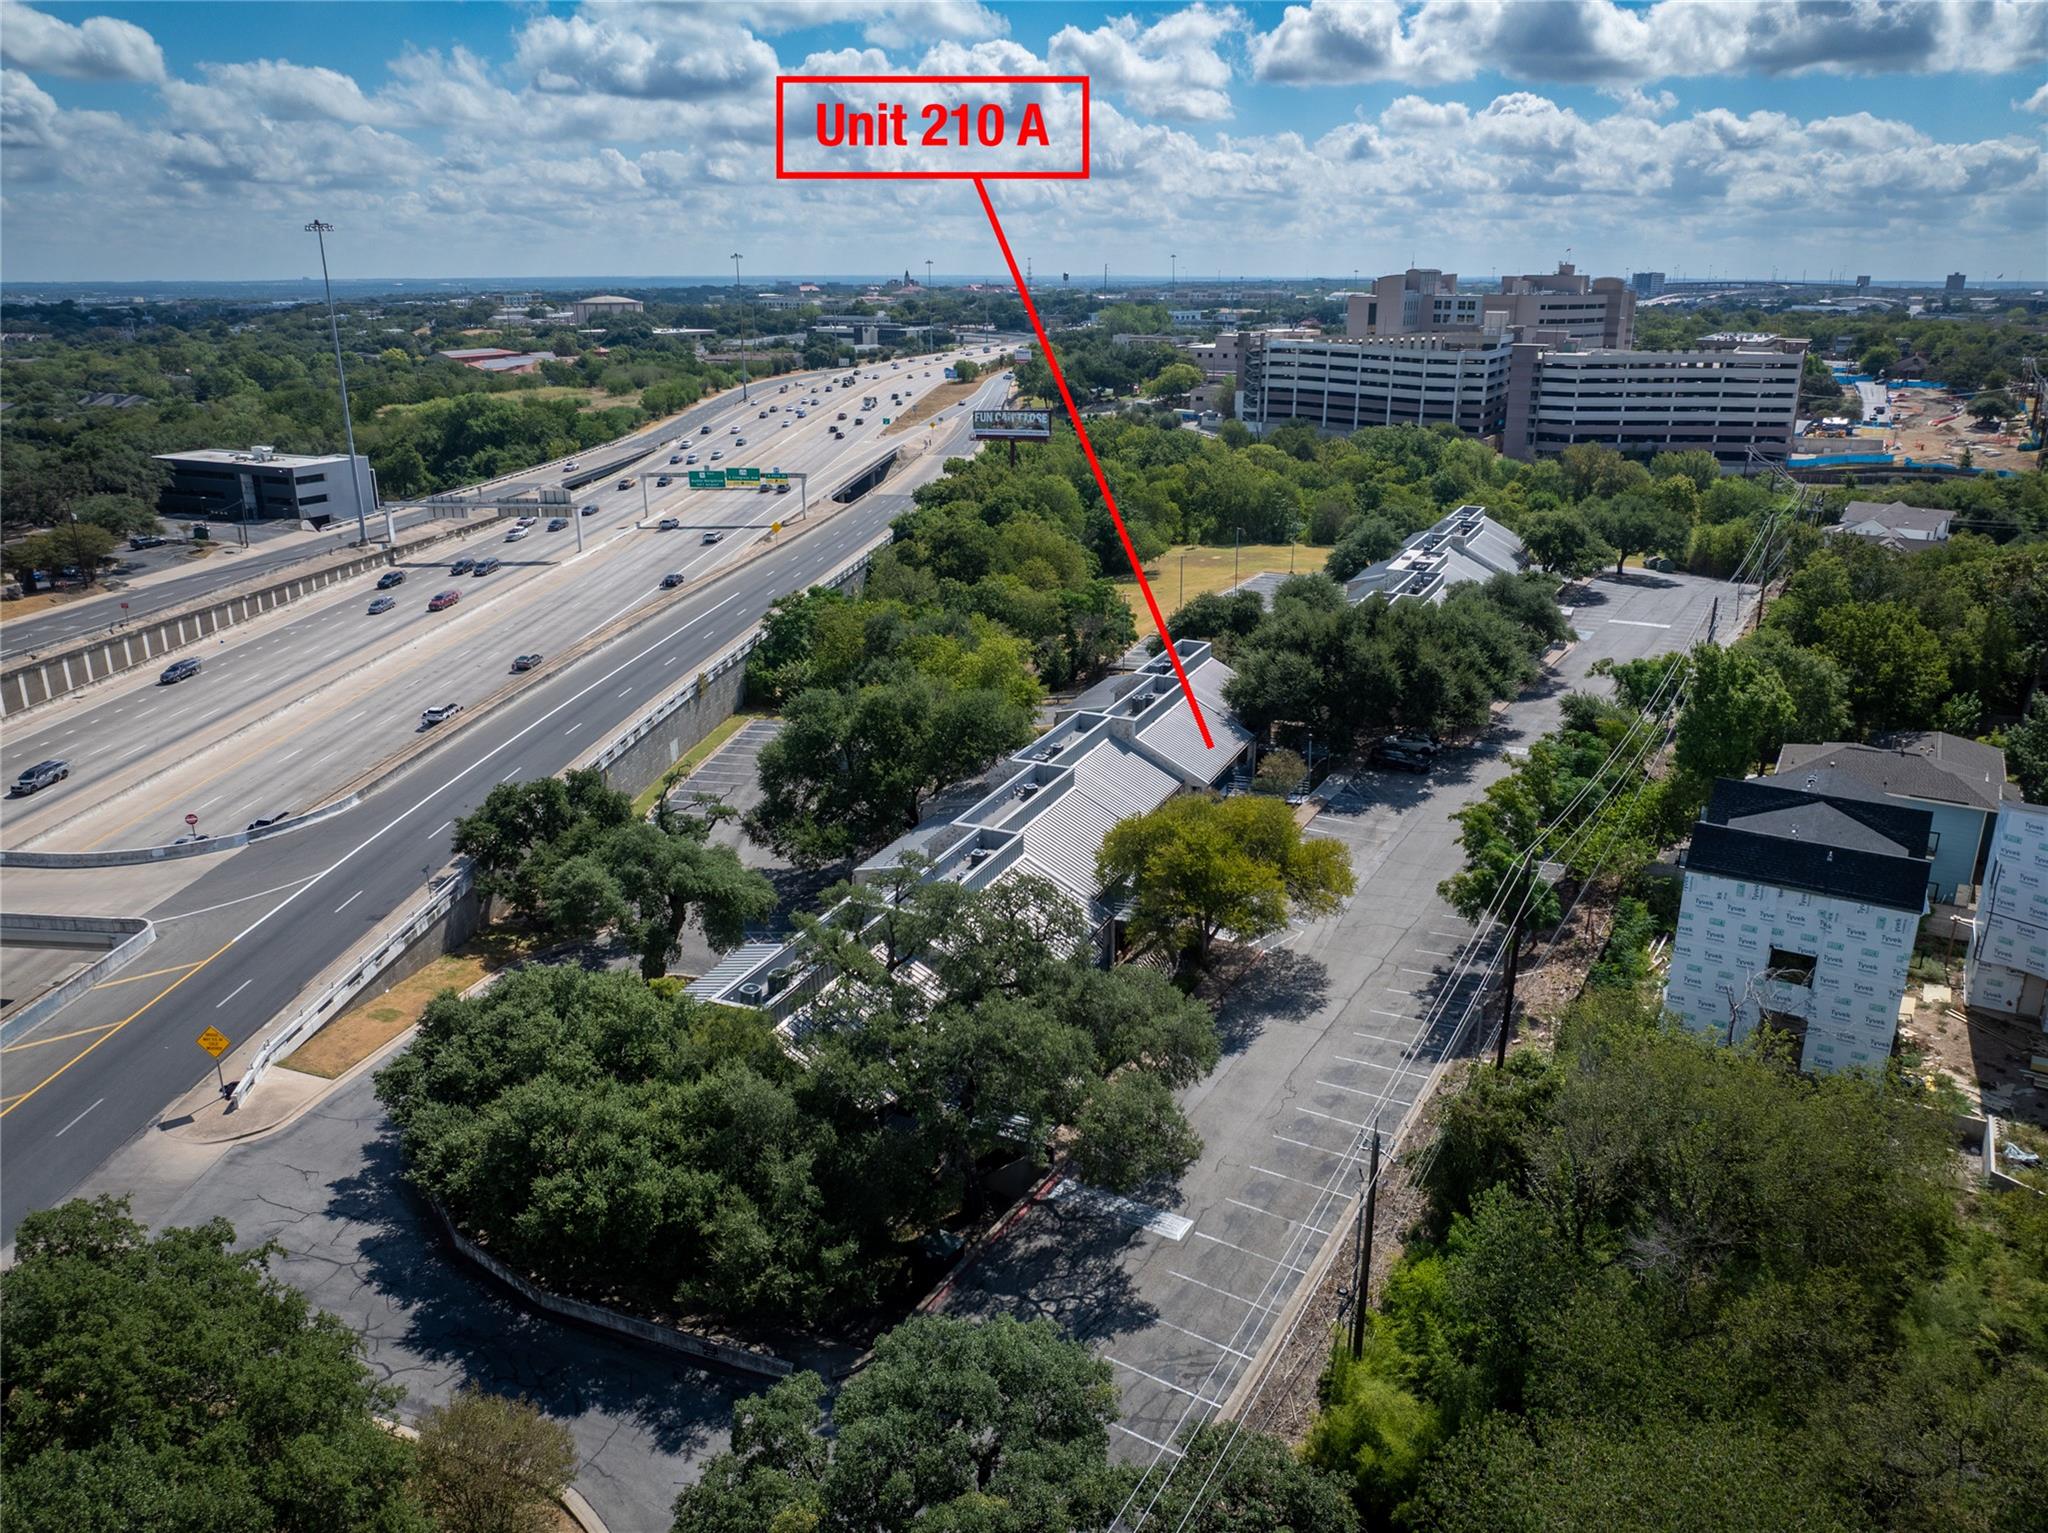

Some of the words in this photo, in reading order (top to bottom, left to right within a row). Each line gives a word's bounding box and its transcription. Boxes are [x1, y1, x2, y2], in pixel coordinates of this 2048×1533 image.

[975, 412, 993, 422] FUN
[1696, 898, 1714, 906] Tyvek
[1727, 904, 1746, 912] Tyvek
[1786, 913, 1806, 921] Tyvek
[1706, 930, 1725, 939] Tyvek
[1846, 927, 1866, 936] Tyvek
[1738, 937, 1757, 946] Tyvek
[1881, 934, 1902, 943] Tyvek
[1704, 951, 1722, 959] Tyvek
[1824, 954, 1843, 963] Tyvek
[1736, 958, 1755, 966] Tyvek
[1858, 961, 1878, 970] Tyvek
[1684, 976, 1702, 984] Tyvek
[1820, 976, 1839, 985] Tyvek
[1854, 983, 1874, 992] Tyvek
[1667, 993, 1685, 1001] Tyvek
[1697, 1000, 1716, 1008] Tyvek
[1831, 1009, 1851, 1018] Tyvek
[1865, 1016, 1886, 1025] Tyvek
[1870, 1039, 1890, 1048] Tyvek
[1814, 1056, 1833, 1065] Tyvek
